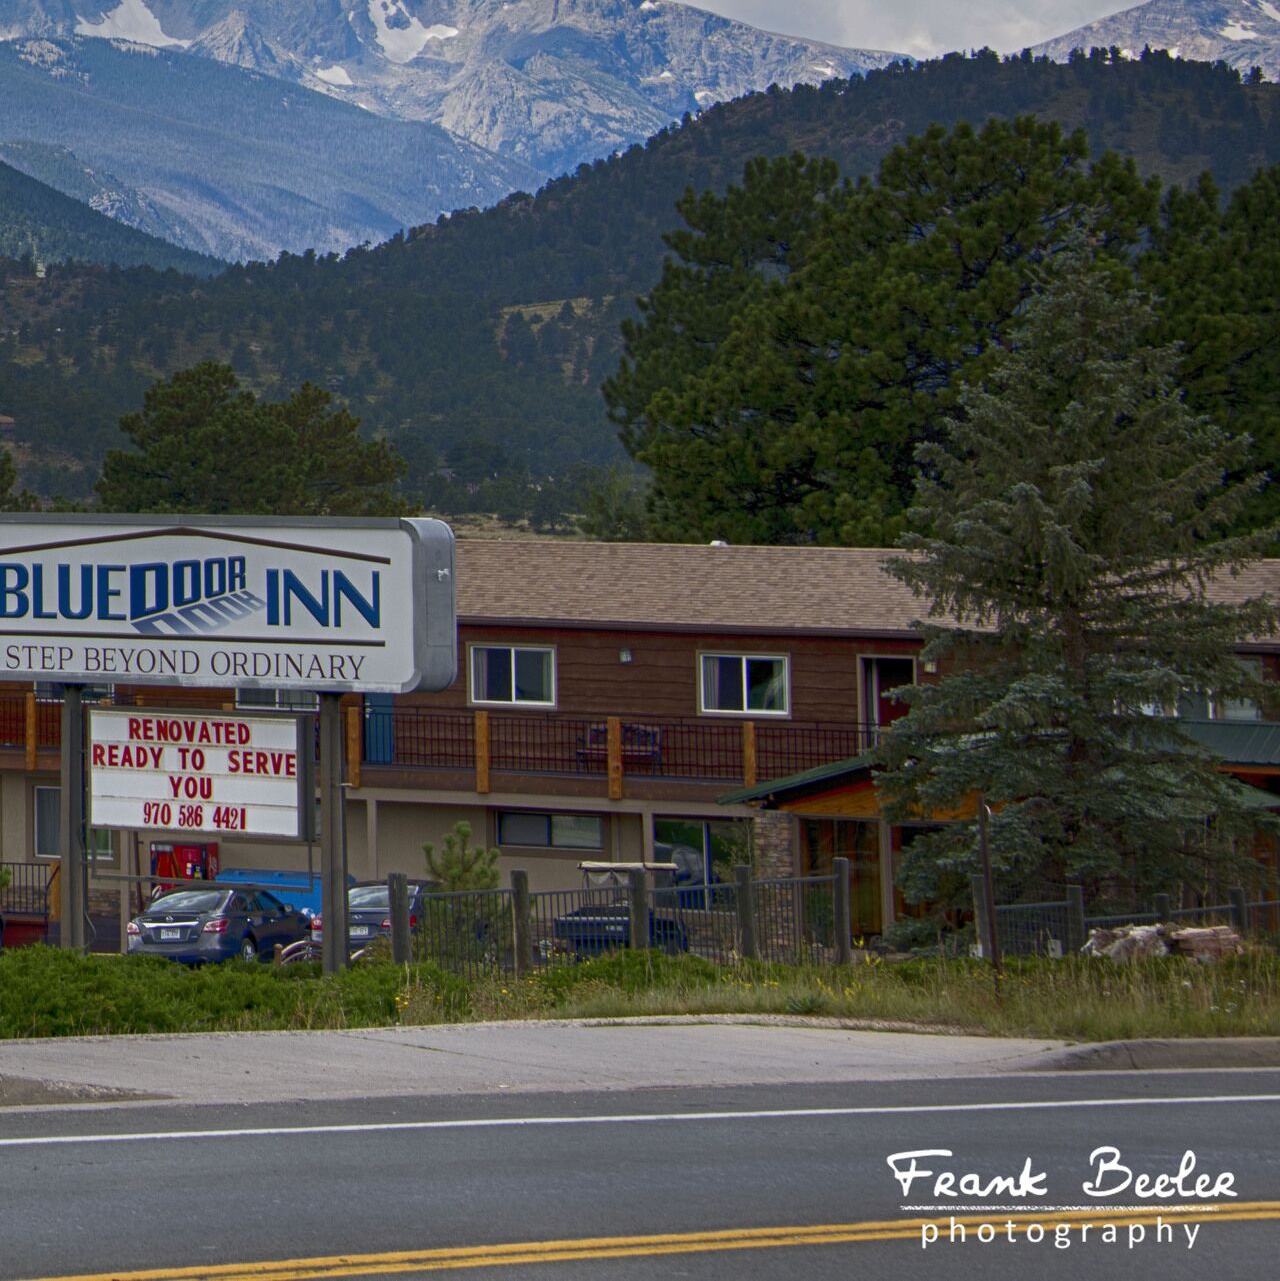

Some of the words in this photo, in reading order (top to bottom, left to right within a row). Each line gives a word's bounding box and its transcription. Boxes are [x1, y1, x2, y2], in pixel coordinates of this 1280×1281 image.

[266, 568, 381, 629] INN
[5, 644, 74, 670] STEP
[83, 647, 200, 674] BEYOND
[210, 650, 366, 680] ORDINARY
[128, 718, 251, 745] RENOVATED
[92, 744, 164, 769] READY
[178, 748, 206, 771] TO
[227, 750, 297, 776] SERVE
[168, 775, 213, 800] YOU
[143, 802, 171, 825] 970
[178, 805, 203, 827] 586
[212, 806, 246, 830] 4421
